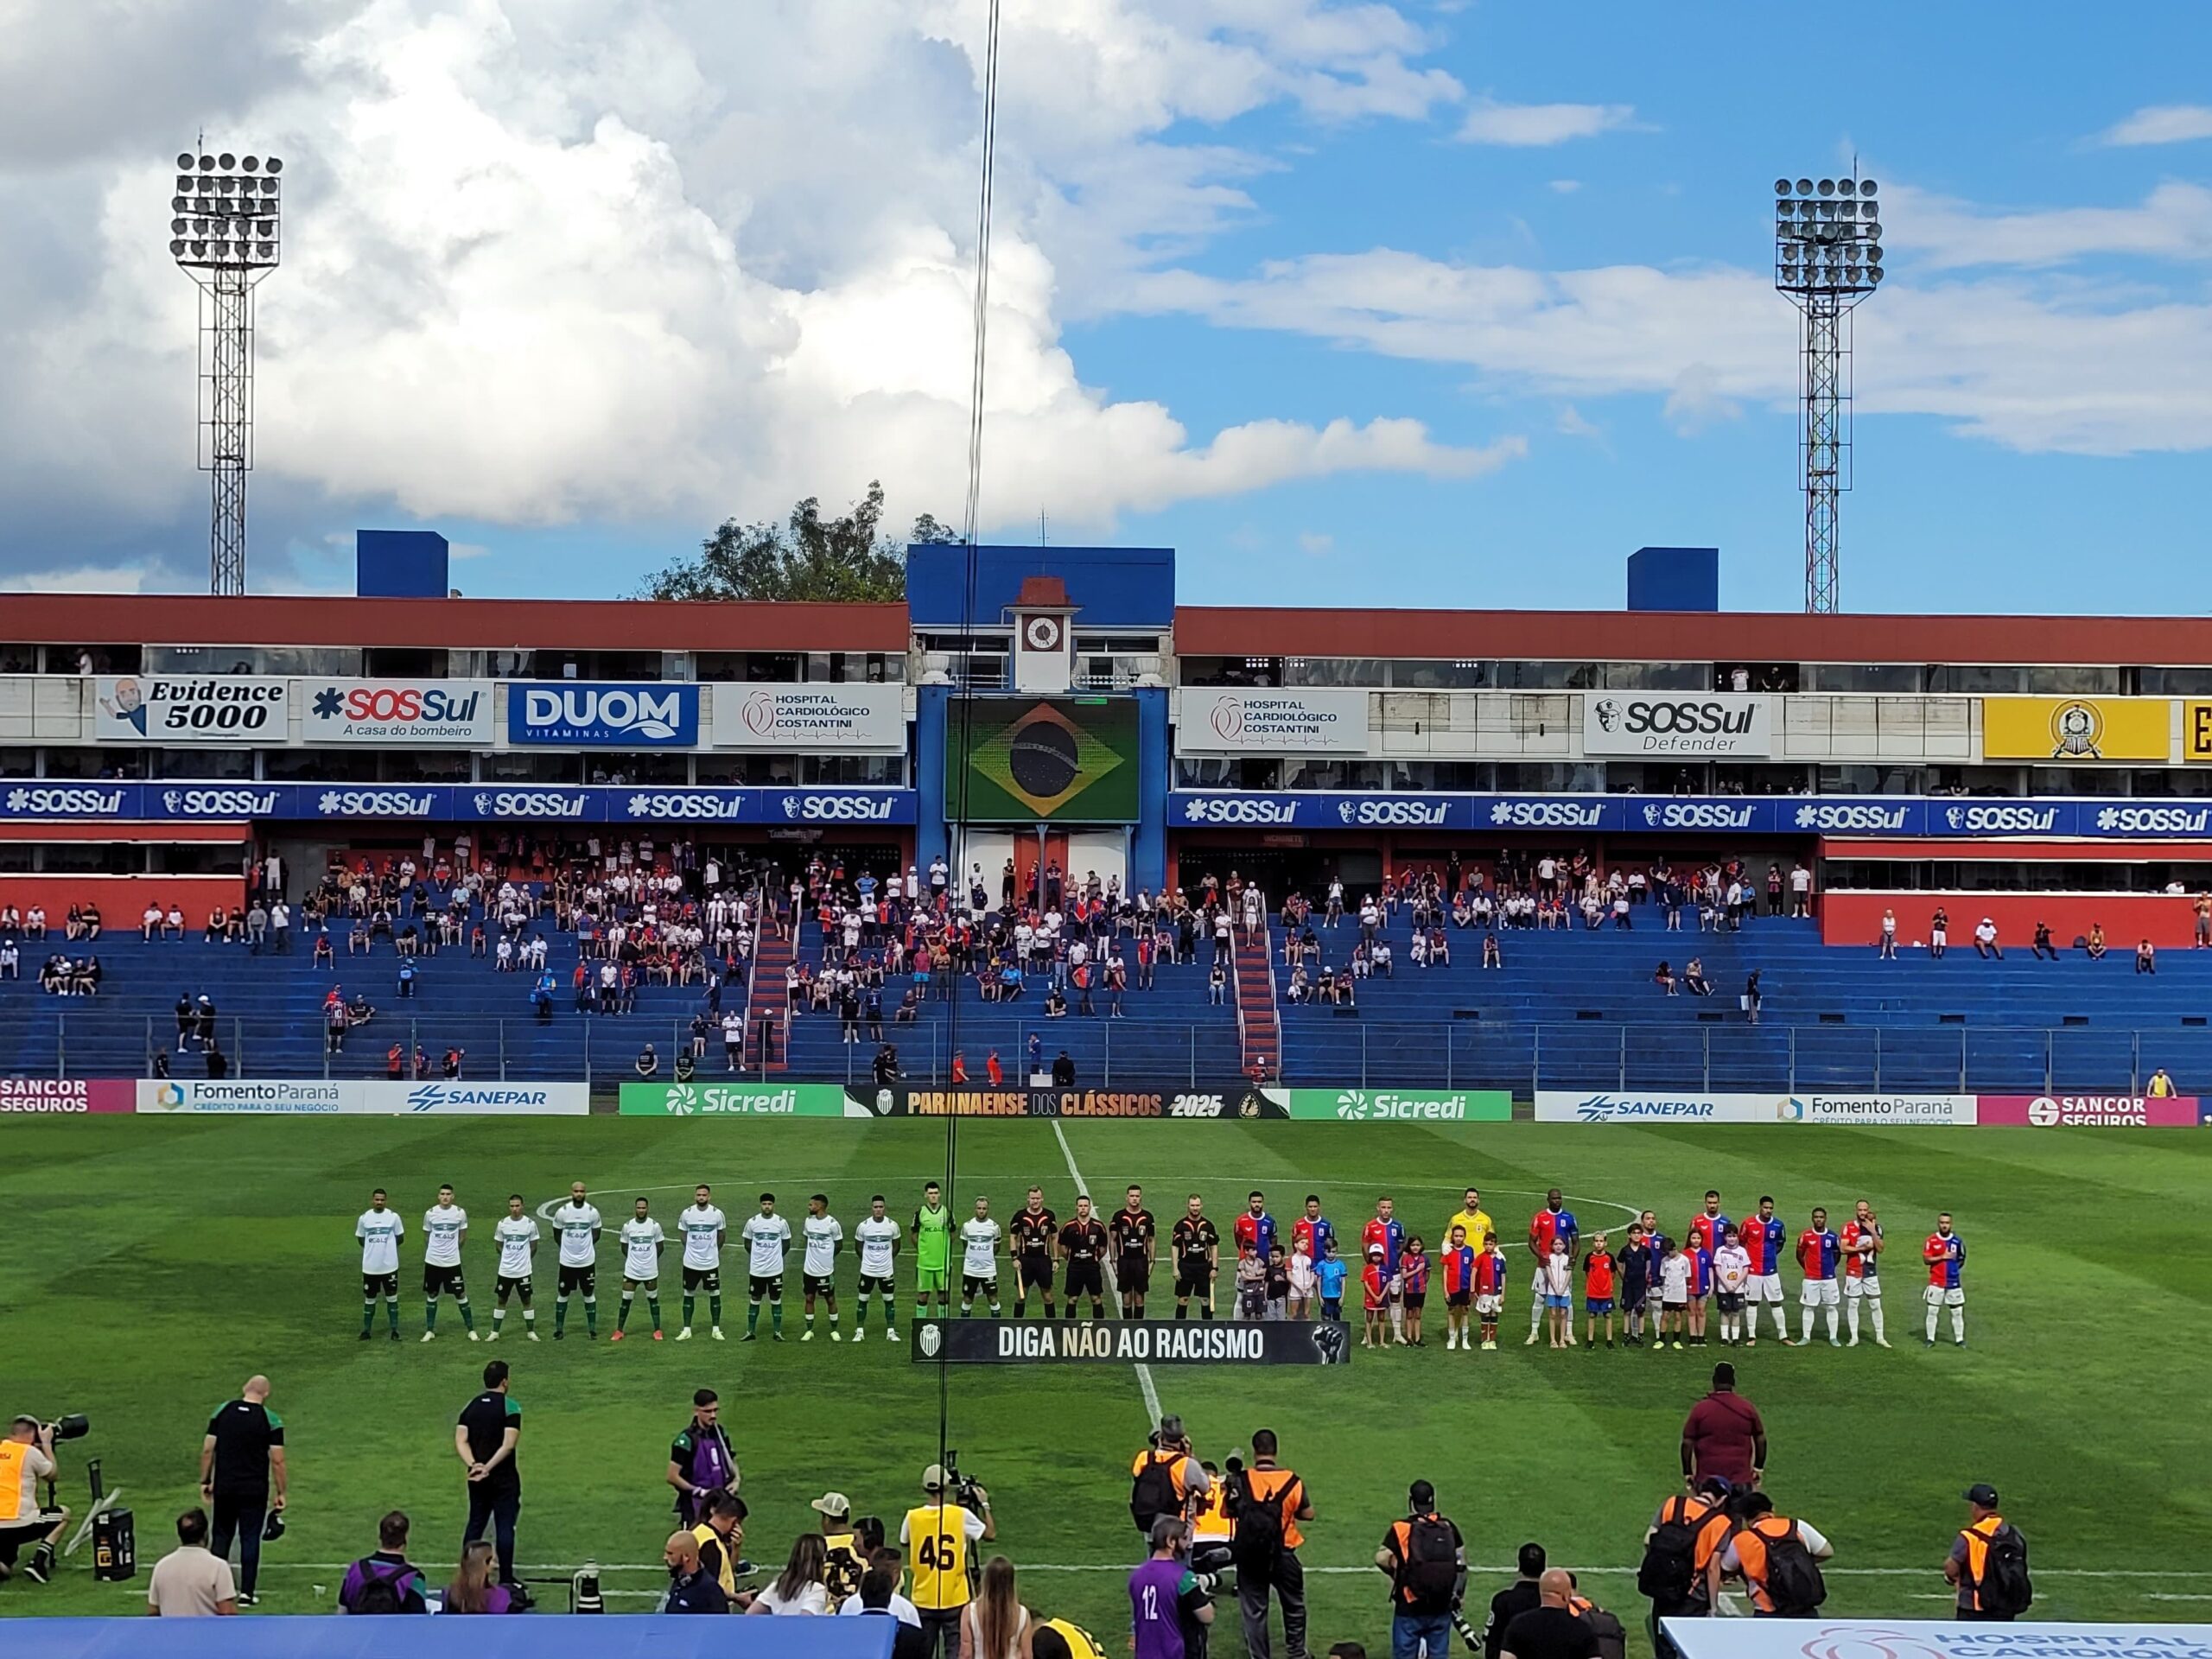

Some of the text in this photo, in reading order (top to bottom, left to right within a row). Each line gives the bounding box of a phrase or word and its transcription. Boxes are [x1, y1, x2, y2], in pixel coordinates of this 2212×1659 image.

[149, 680, 283, 702] Evidence
[775, 695, 837, 704] HOSPITAL
[1243, 700, 1306, 709] HOSPITAL
[164, 704, 267, 729] 5000
[526, 690, 680, 728] DUOM
[775, 704, 870, 716] CARDIOLÓGICO
[1243, 709, 1338, 722] CARDIOLÓGICO
[343, 724, 472, 736] A casa do bombeiro
[775, 719, 852, 728] COSTANTINI
[1243, 723, 1319, 734] COSTANTINI
[526, 728, 609, 738] VITAMINAS
[1643, 735, 1737, 751] Defender
[0, 1080, 87, 1095] SANCOR
[0, 1097, 87, 1112] SEGUROS
[448, 1090, 547, 1105] SANEPAR
[702, 1089, 797, 1113] Sicredi
[1033, 1093, 1057, 1116] DOS
[1060, 1090, 1162, 1116] CLÁSSICOS
[1171, 1094, 1223, 1116] 2025
[2062, 1097, 2145, 1113] SANCOR
[194, 1102, 235, 1111] CRÉDITO
[294, 1102, 339, 1112] NEGÓCIO
[1372, 1095, 1467, 1118] Sicredi
[1617, 1102, 1714, 1116] SANEPAR
[998, 1321, 1264, 1359] DIGA NÃO AO RACISMO
[918, 1534, 956, 1572] 46
[1141, 1585, 1159, 1621] 12
[1934, 1633, 2207, 1647] HOSPITAL
